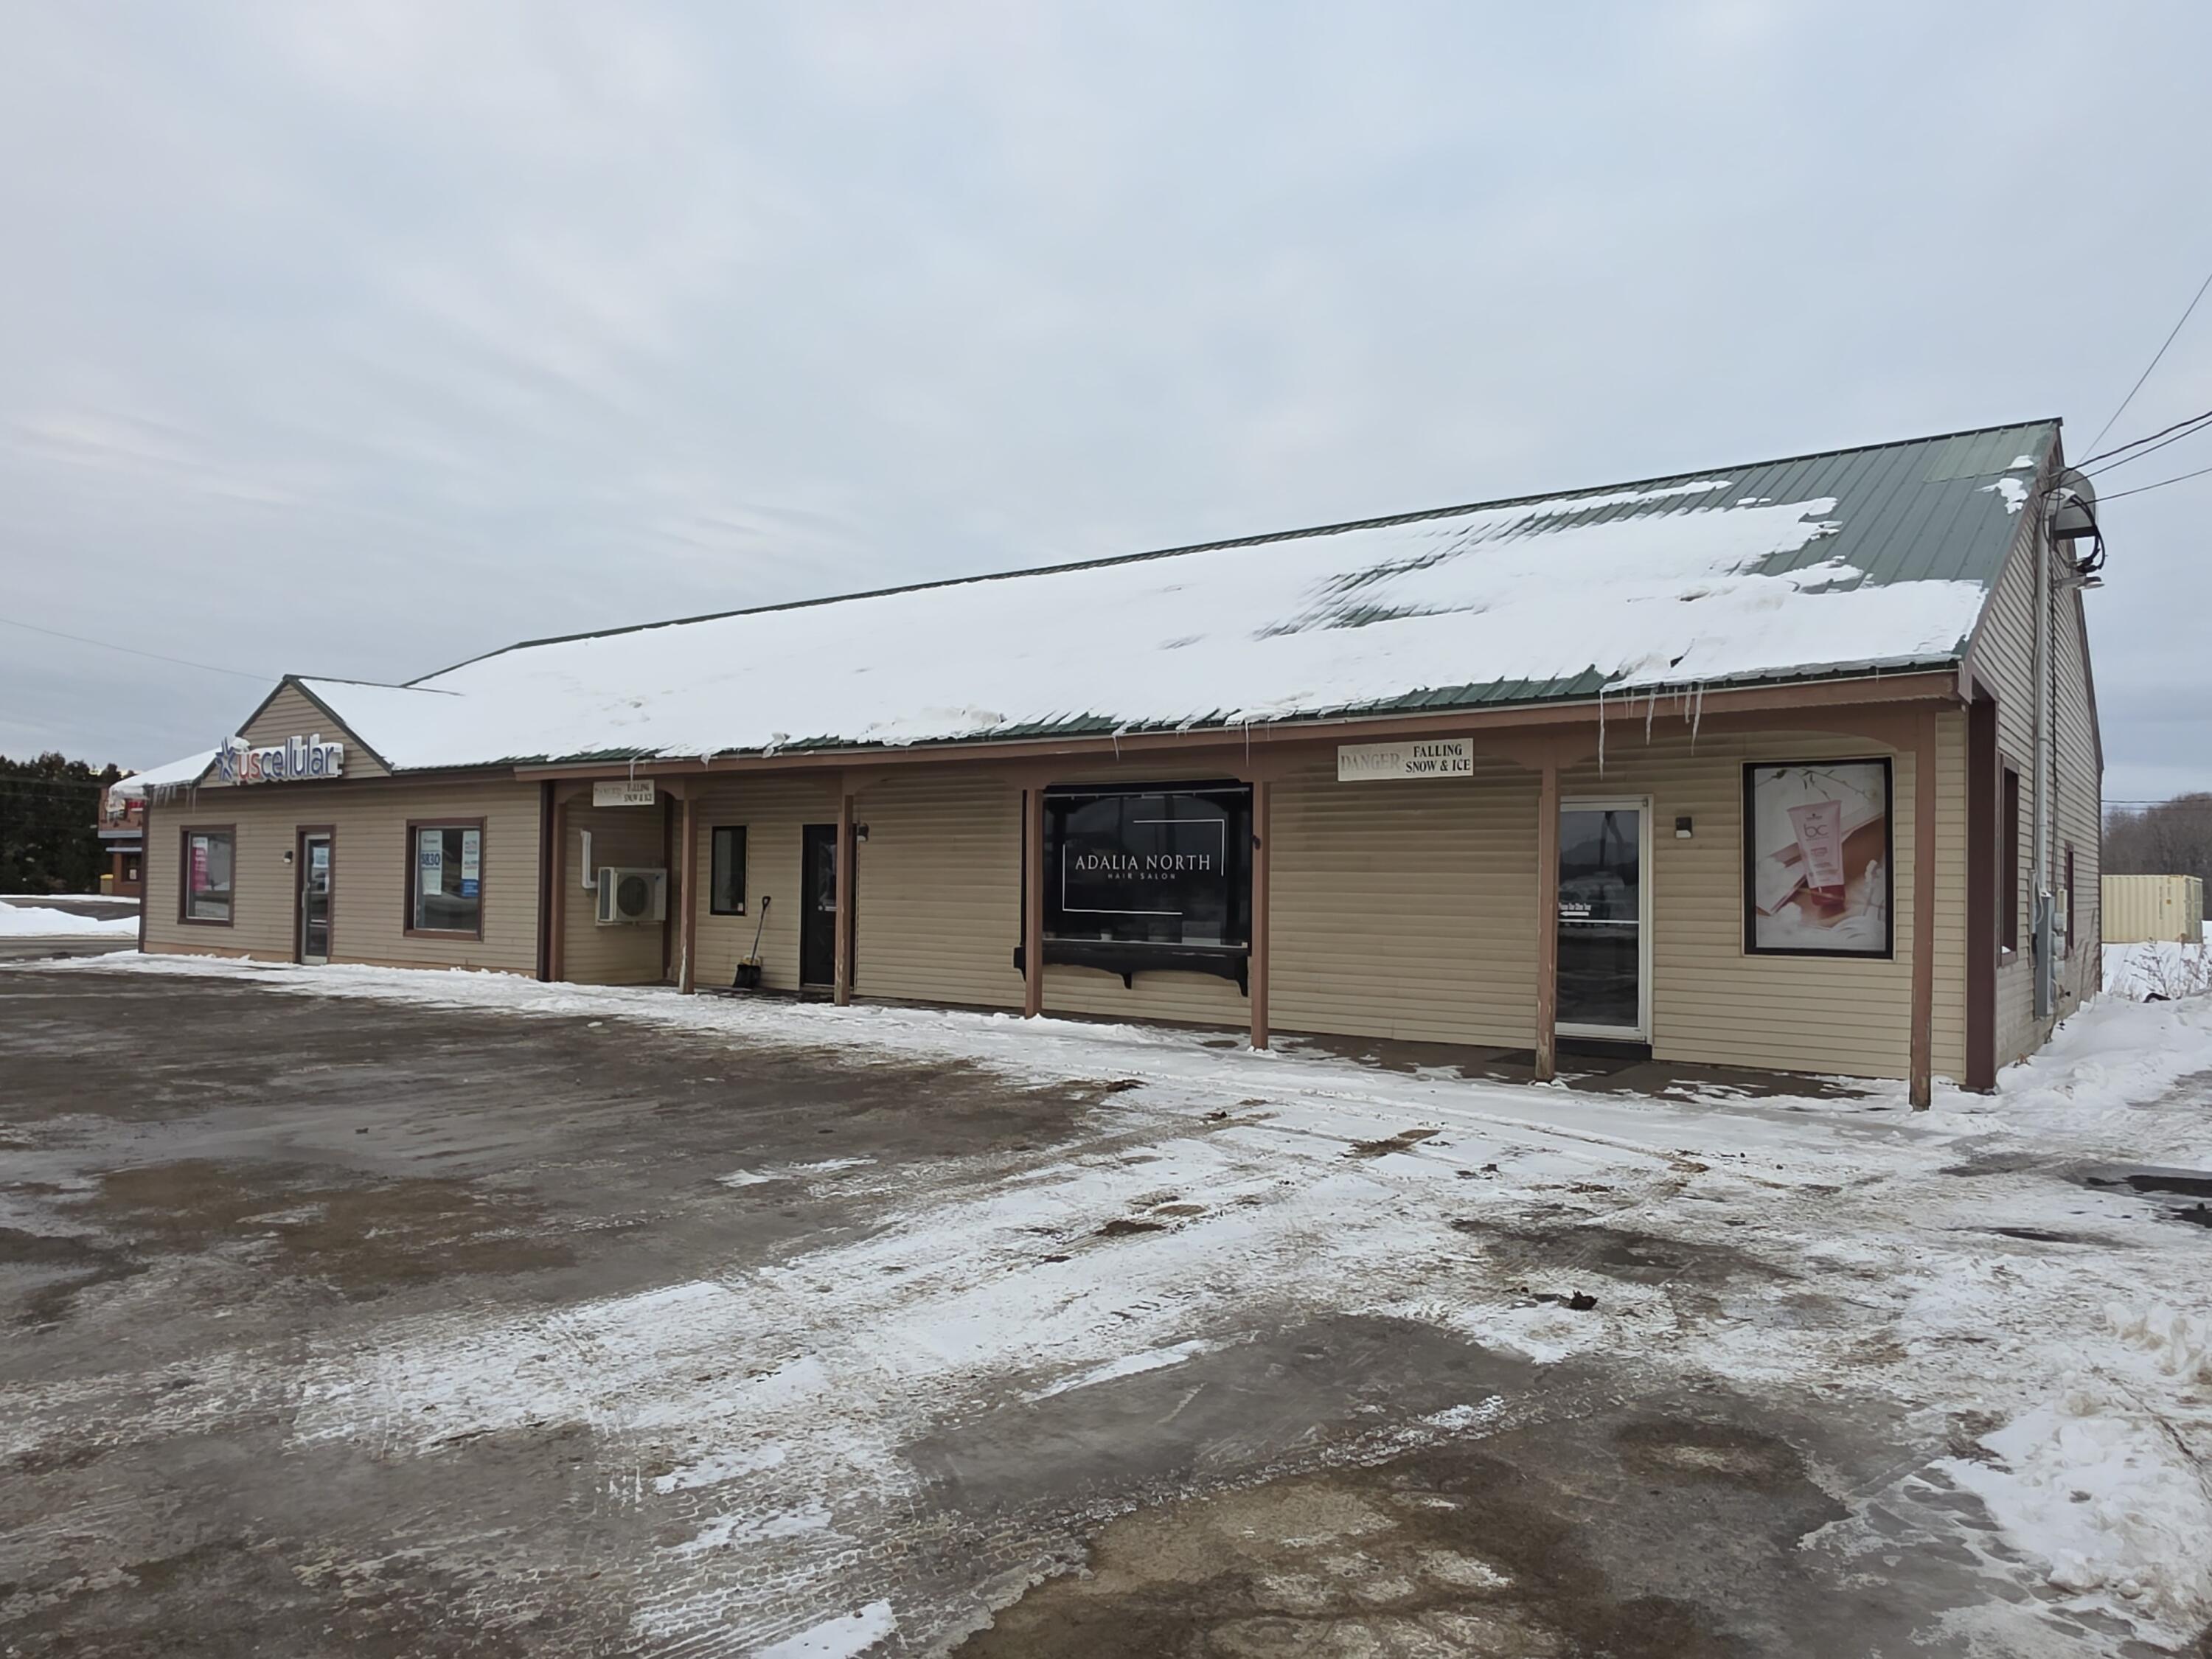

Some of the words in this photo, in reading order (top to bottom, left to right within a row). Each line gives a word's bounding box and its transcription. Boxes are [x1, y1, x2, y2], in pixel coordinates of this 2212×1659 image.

[1413, 743, 1462, 758] FALLING
[1340, 752, 1400, 771] DANGER
[1405, 759, 1437, 773] SNOW
[1439, 759, 1448, 772] &
[1452, 758, 1471, 771] ICE
[1074, 854, 1138, 871] ADALIA
[1146, 854, 1211, 871] NORTH
[1140, 872, 1176, 880] SALON
